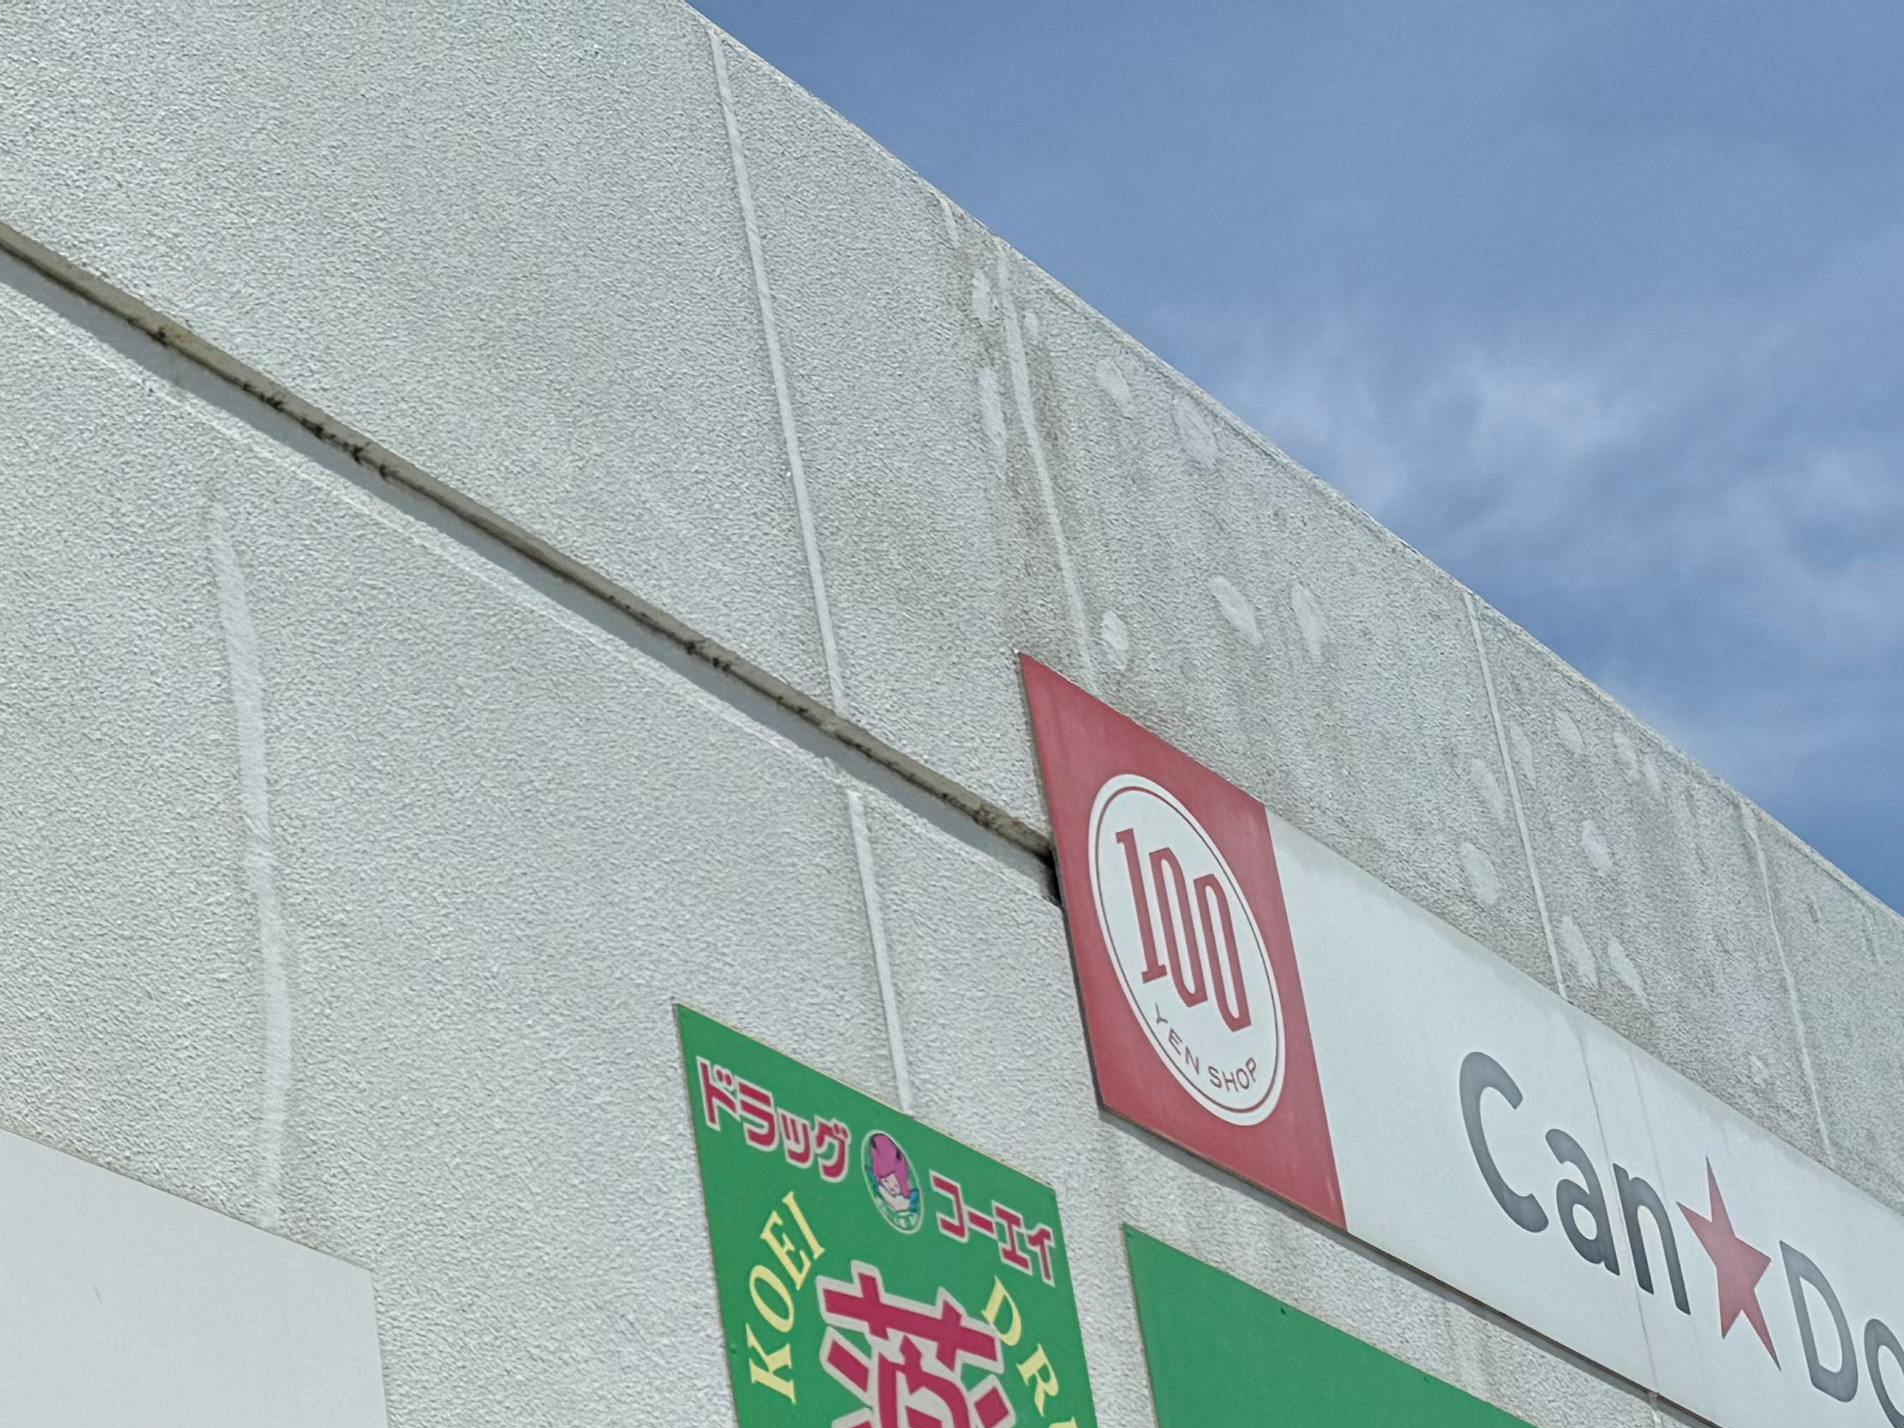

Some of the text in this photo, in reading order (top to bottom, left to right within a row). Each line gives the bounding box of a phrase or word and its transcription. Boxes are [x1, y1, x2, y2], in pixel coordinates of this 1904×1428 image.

[1116, 828, 1252, 1033] 100
[1155, 1002, 1258, 1093] YEN SHOP
[696, 1055, 1056, 1288] ドラッグ コーエイ
[1459, 1051, 1691, 1316] Can
[745, 1190, 826, 1404] KOEI
